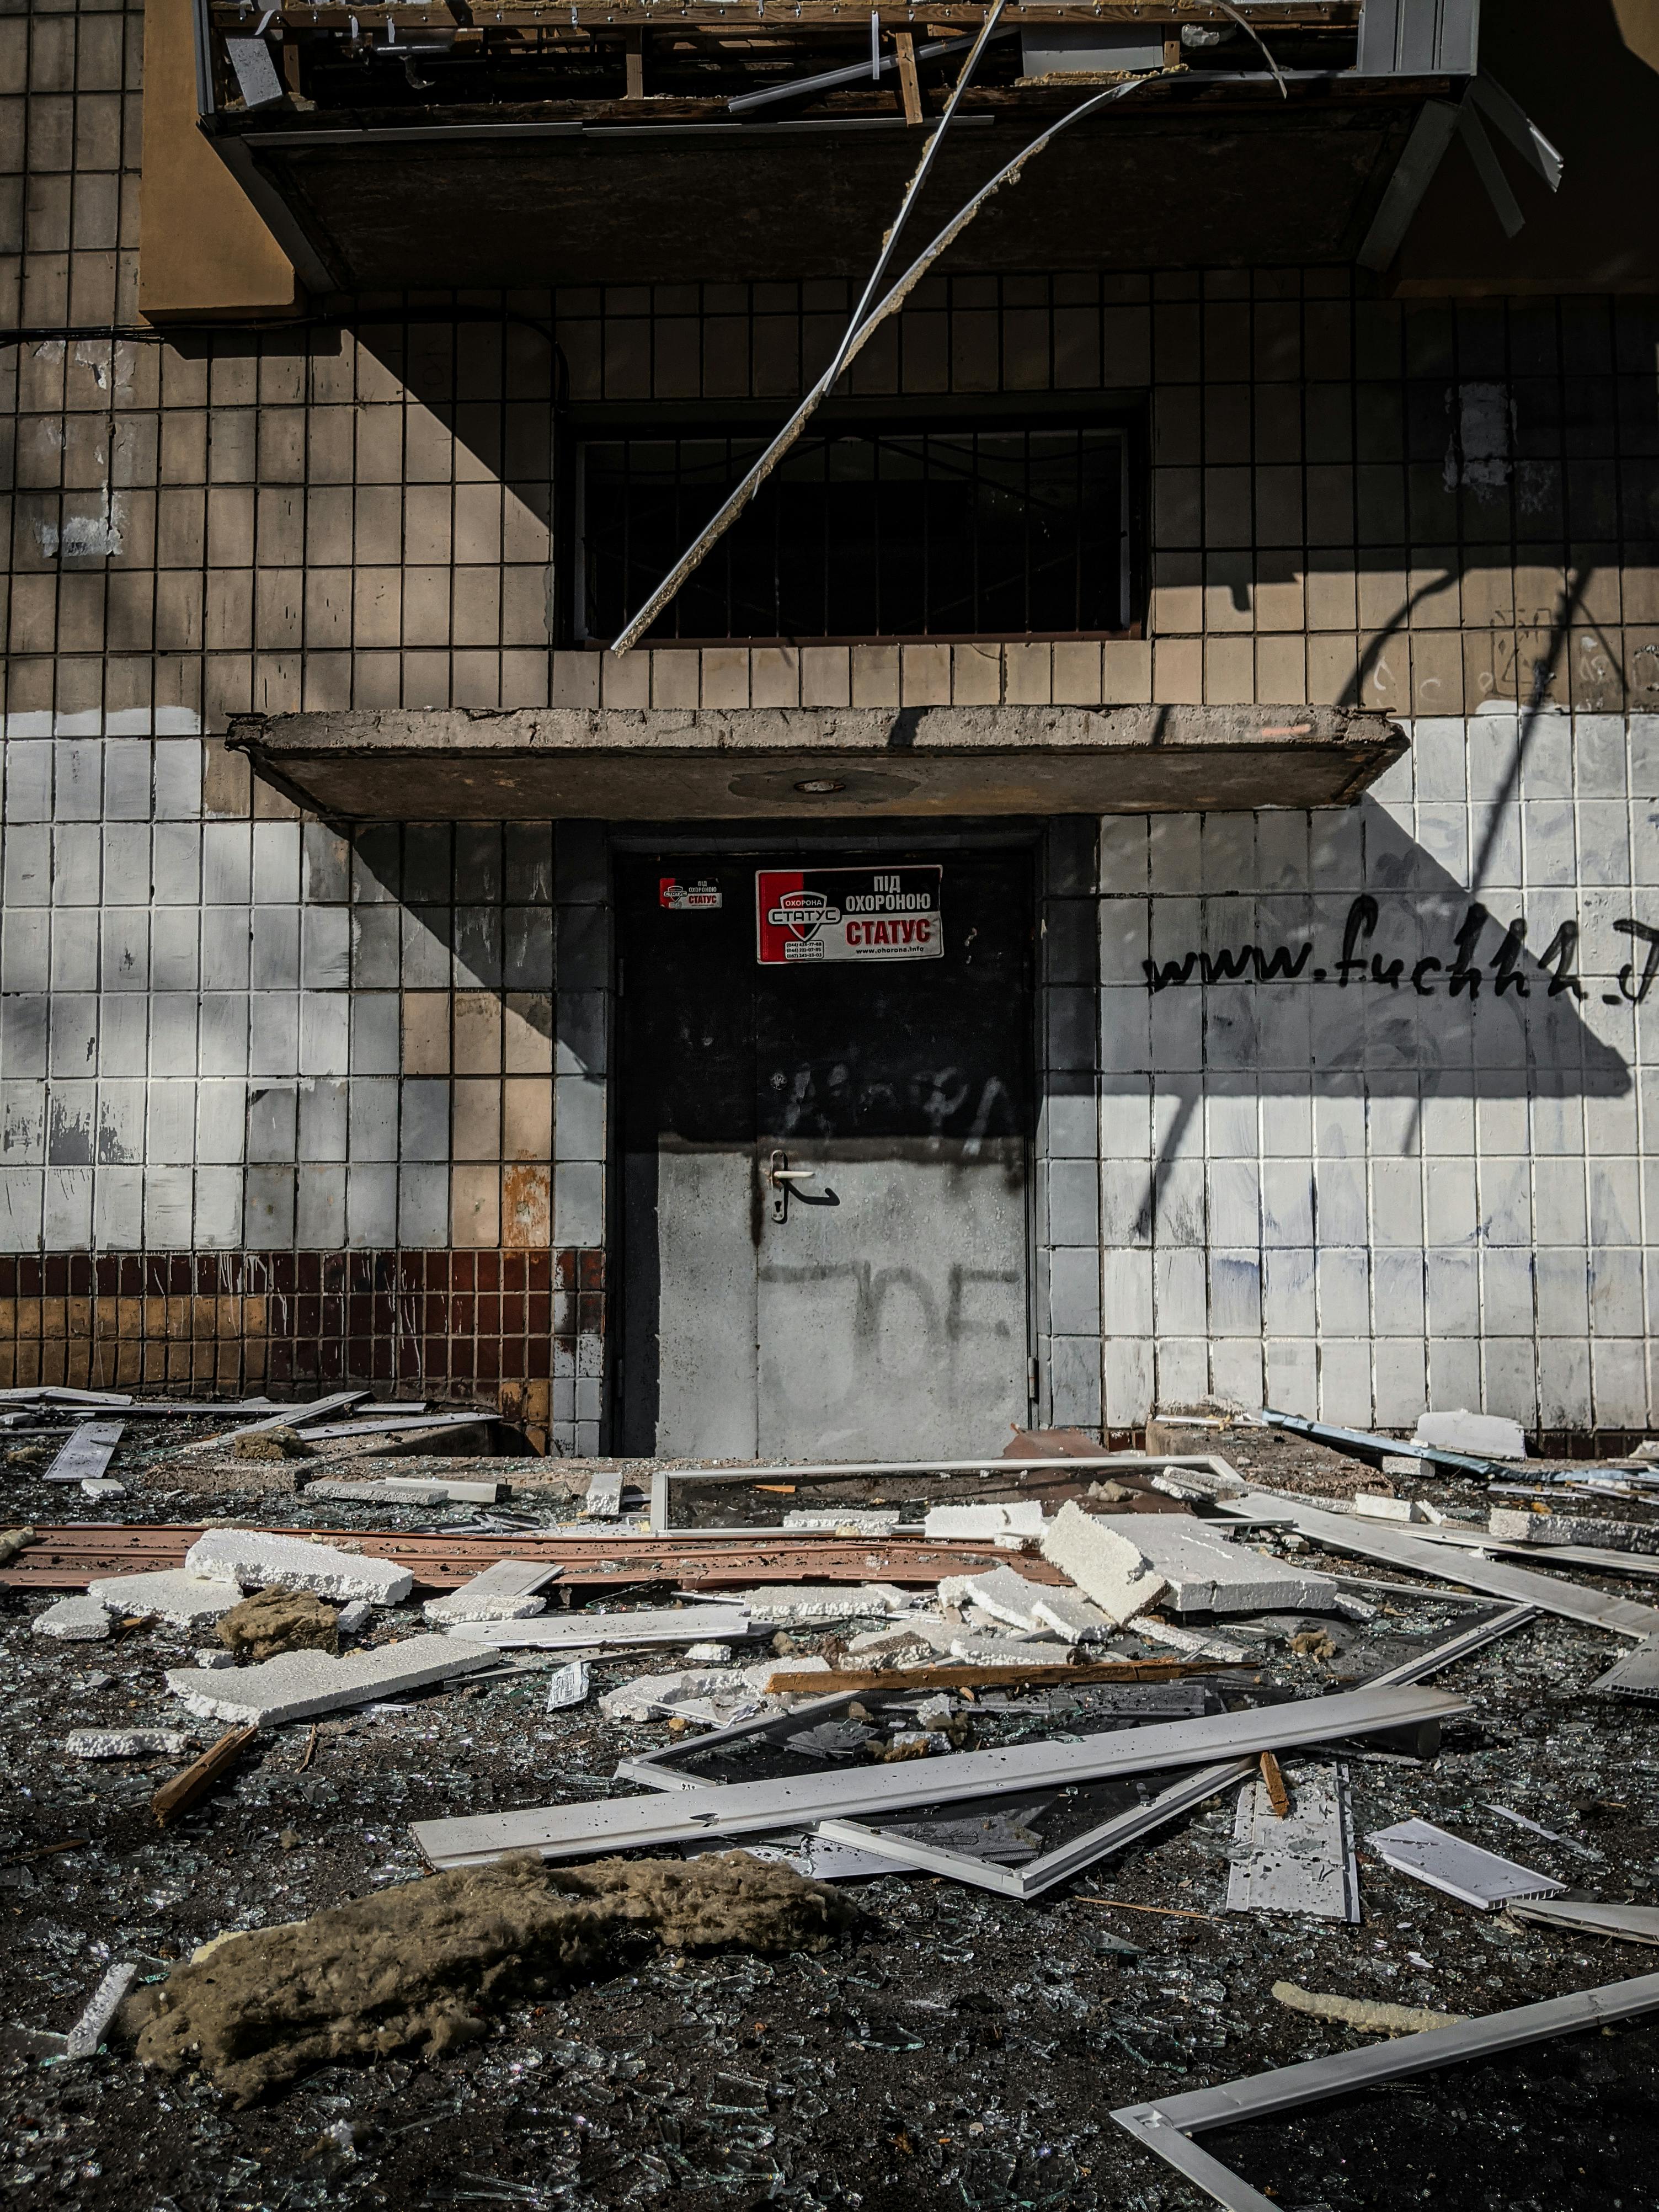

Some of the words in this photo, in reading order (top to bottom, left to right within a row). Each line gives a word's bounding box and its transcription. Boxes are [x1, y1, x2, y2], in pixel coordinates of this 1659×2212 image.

[873, 875, 901, 893] ПІД
[845, 893, 931, 912] ОХОРОНОЮ
[772, 910, 837, 922] СТАТУС
[846, 919, 931, 945] СТАТУС
